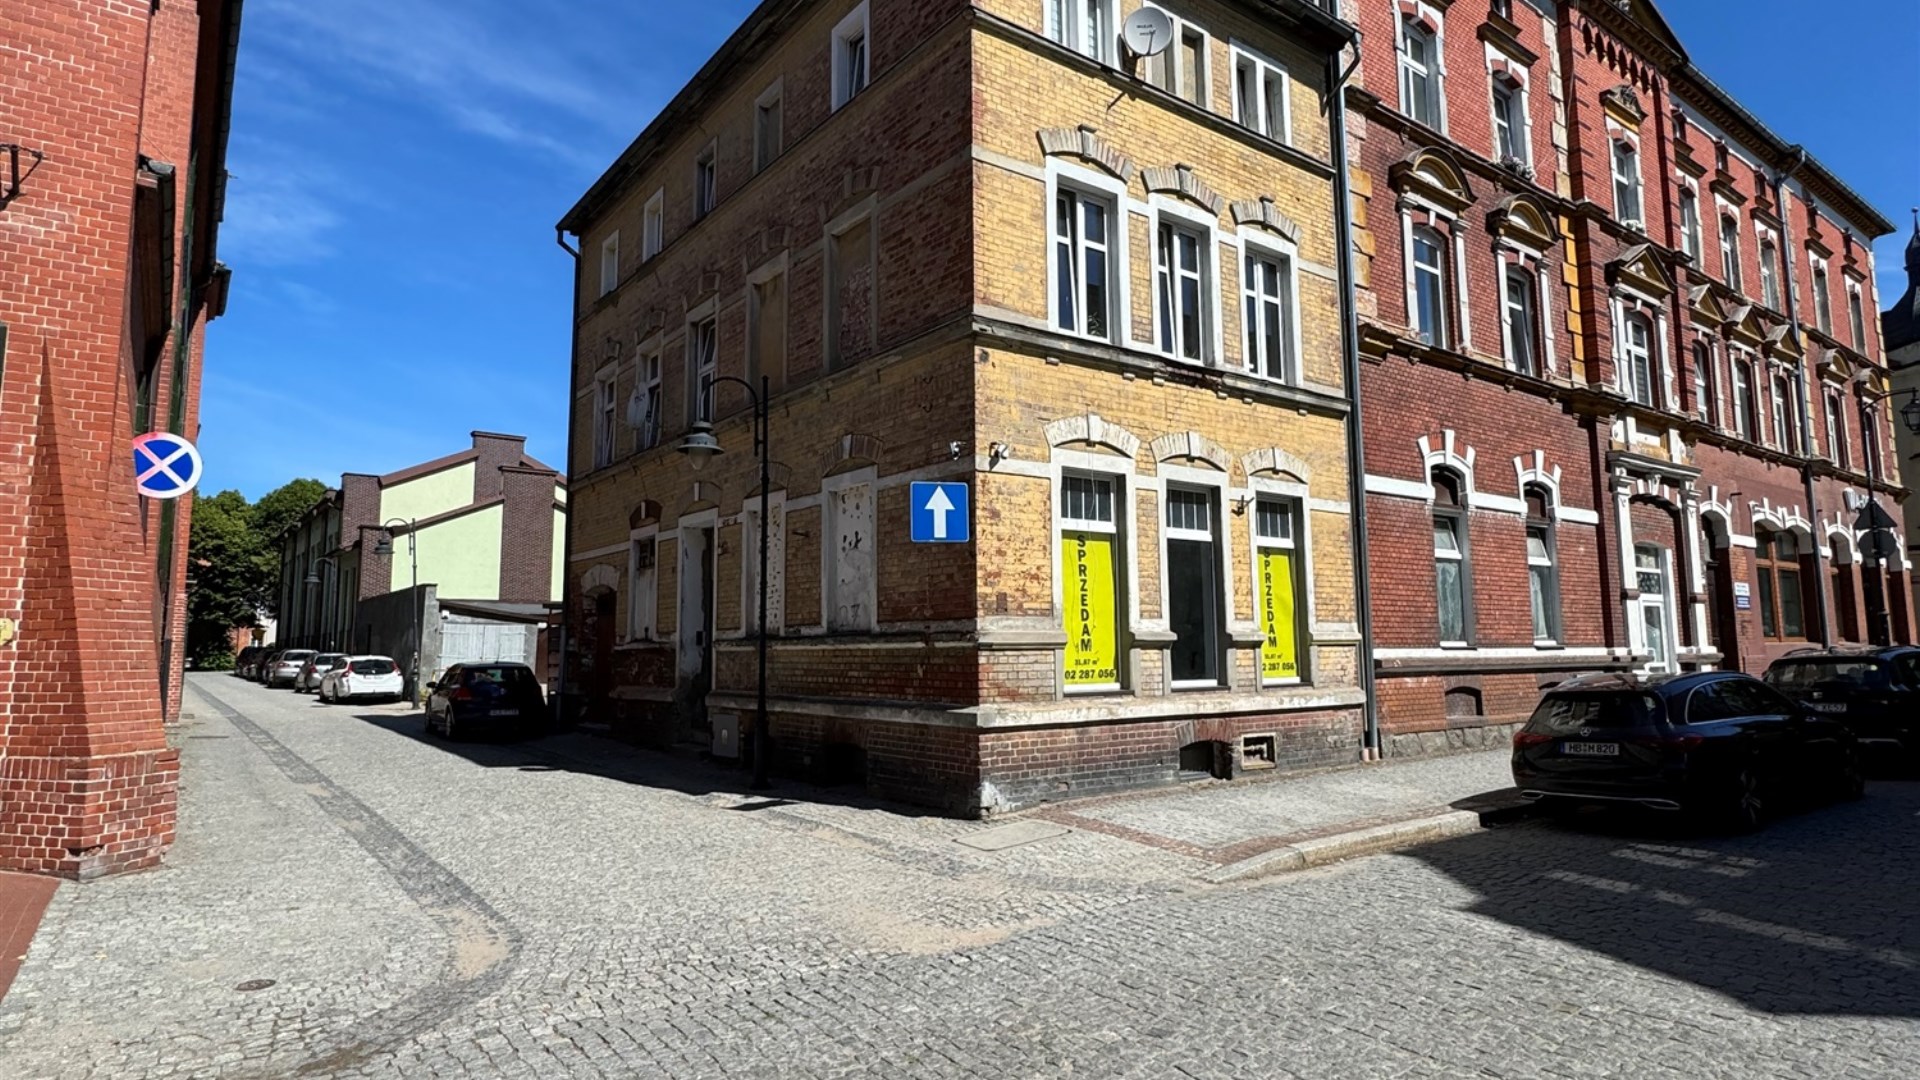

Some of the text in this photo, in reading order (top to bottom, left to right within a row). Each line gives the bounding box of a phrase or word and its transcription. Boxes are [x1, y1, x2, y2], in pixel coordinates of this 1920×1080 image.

[1077, 534, 1092, 652] SPRZEDAM
[1263, 547, 1277, 648] SPRZEDAM
[1079, 669, 1096, 679] 287
[1098, 668, 1115, 678] 056
